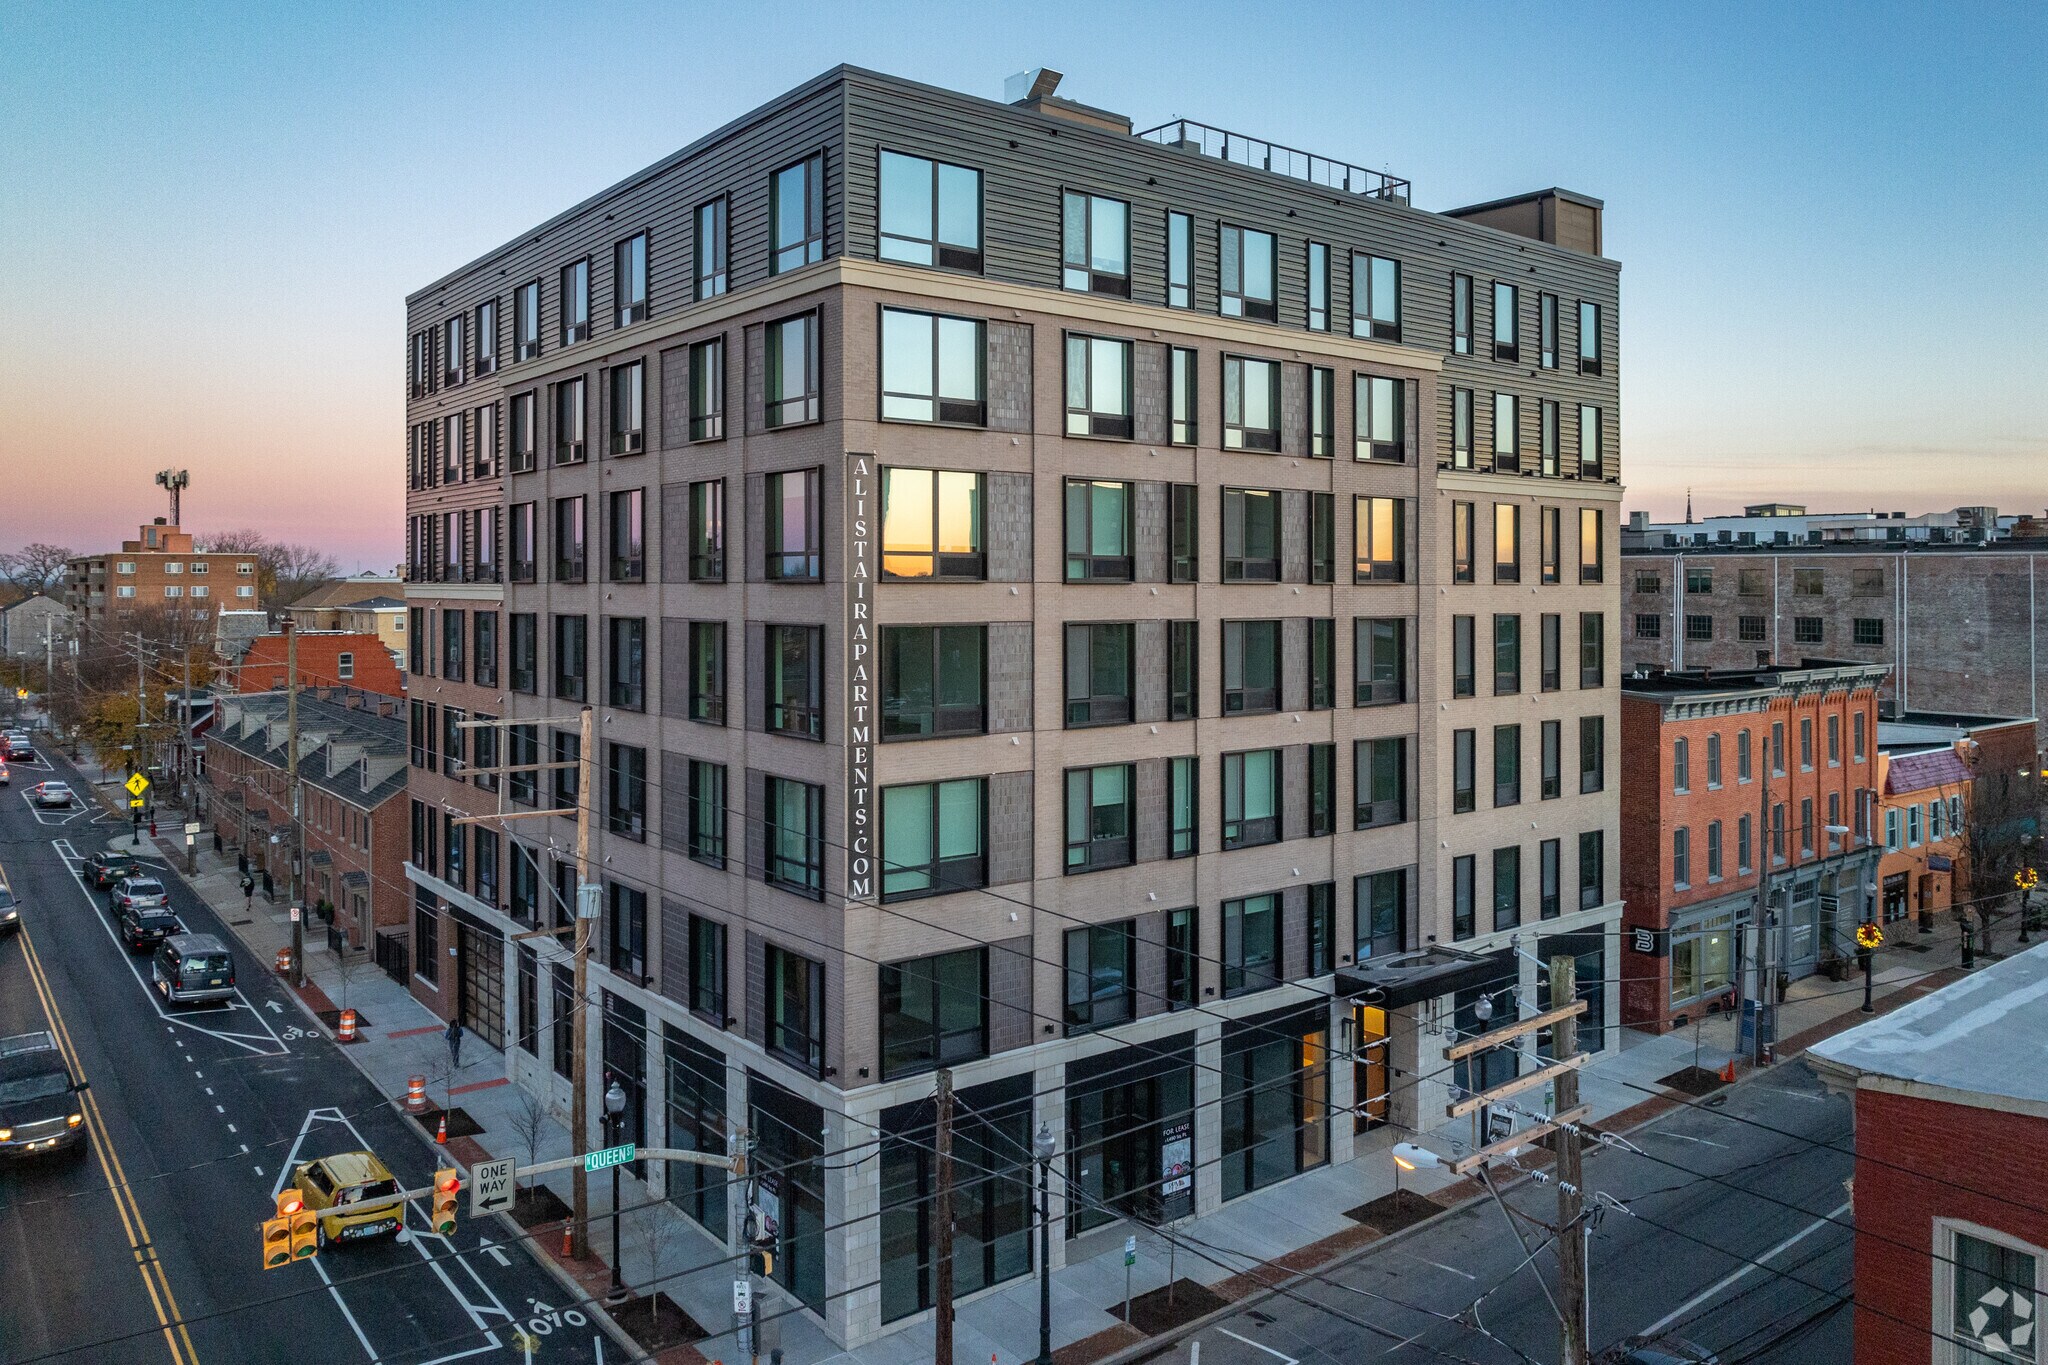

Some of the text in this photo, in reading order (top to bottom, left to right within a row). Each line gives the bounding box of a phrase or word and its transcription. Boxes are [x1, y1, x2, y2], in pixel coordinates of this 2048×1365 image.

[1163, 1123, 1190, 1136] FOR LEASE
[586, 1145, 633, 1169] N QUEEN ST
[481, 1163, 507, 1180] ONE
[480, 1178, 507, 1195] WAY
